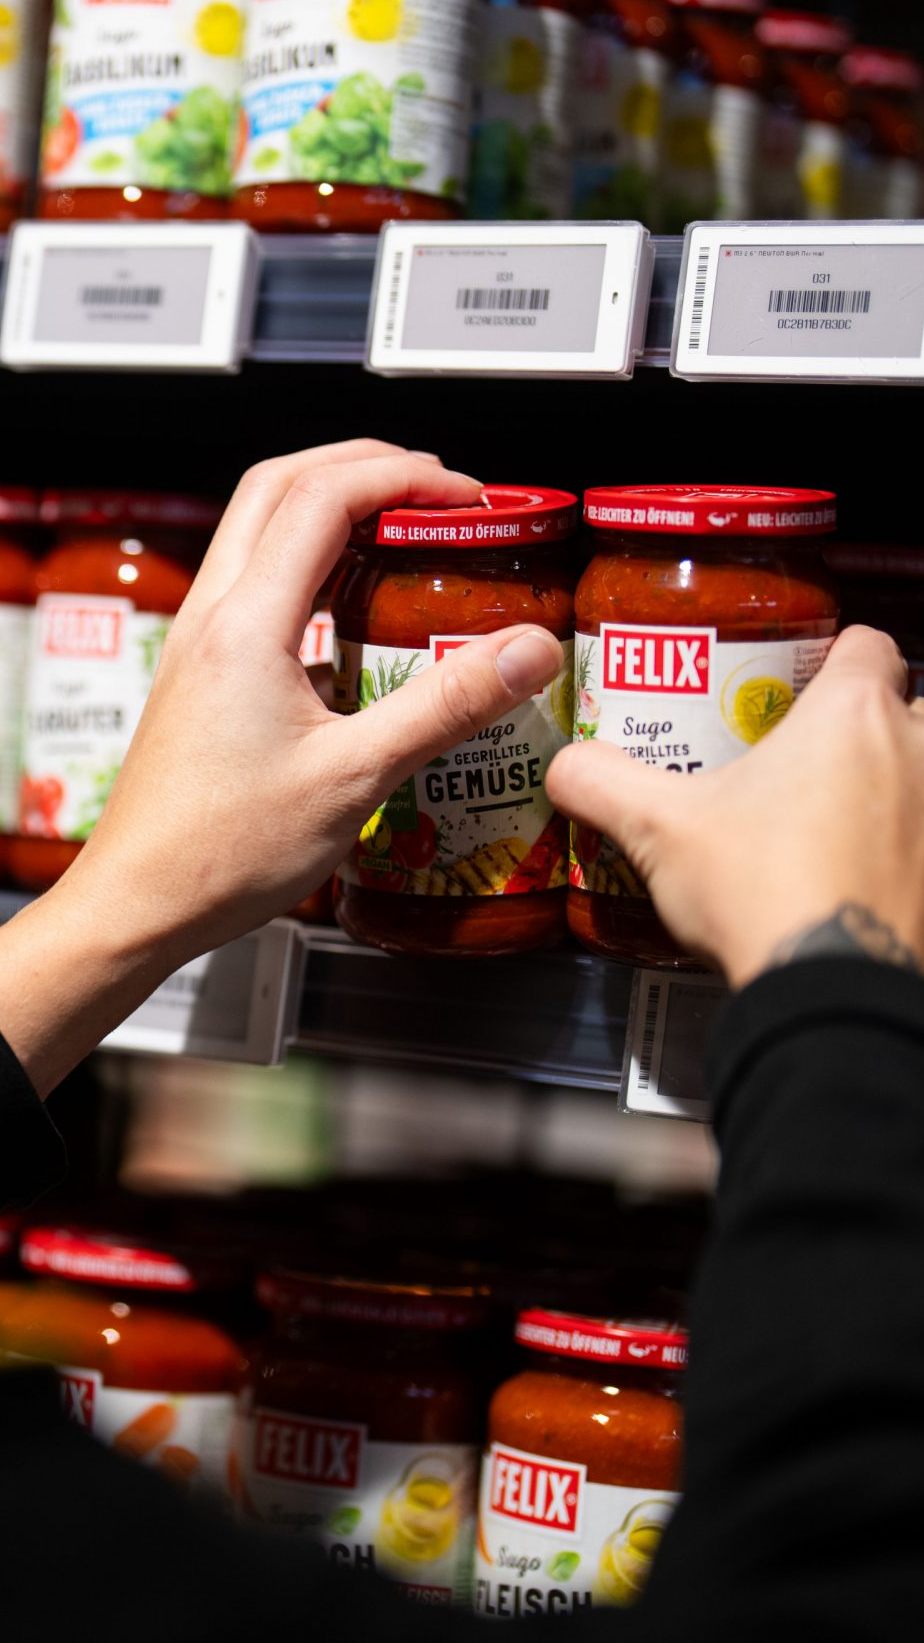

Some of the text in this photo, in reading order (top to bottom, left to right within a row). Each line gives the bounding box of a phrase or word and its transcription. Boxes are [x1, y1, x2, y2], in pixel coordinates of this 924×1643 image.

[812, 273, 831, 284] 031
[632, 508, 646, 524] ZU
[646, 506, 694, 527] ÖFFNEN!
[747, 512, 774, 527] NEU:
[383, 523, 520, 541] NEU: LEICHTER ZU ÖFFNEN!
[608, 636, 702, 687] FELIX
[465, 723, 515, 745] ugo
[623, 716, 672, 742] Sugo
[454, 743, 530, 765] GEGRILLTES
[425, 757, 542, 803] GEMÜSE
[571, 1329, 621, 1356] ÖFFNEN!
[264, 1422, 354, 1482] FELIX
[493, 1457, 572, 1525] FELIX
[498, 1547, 542, 1578] Sugo
